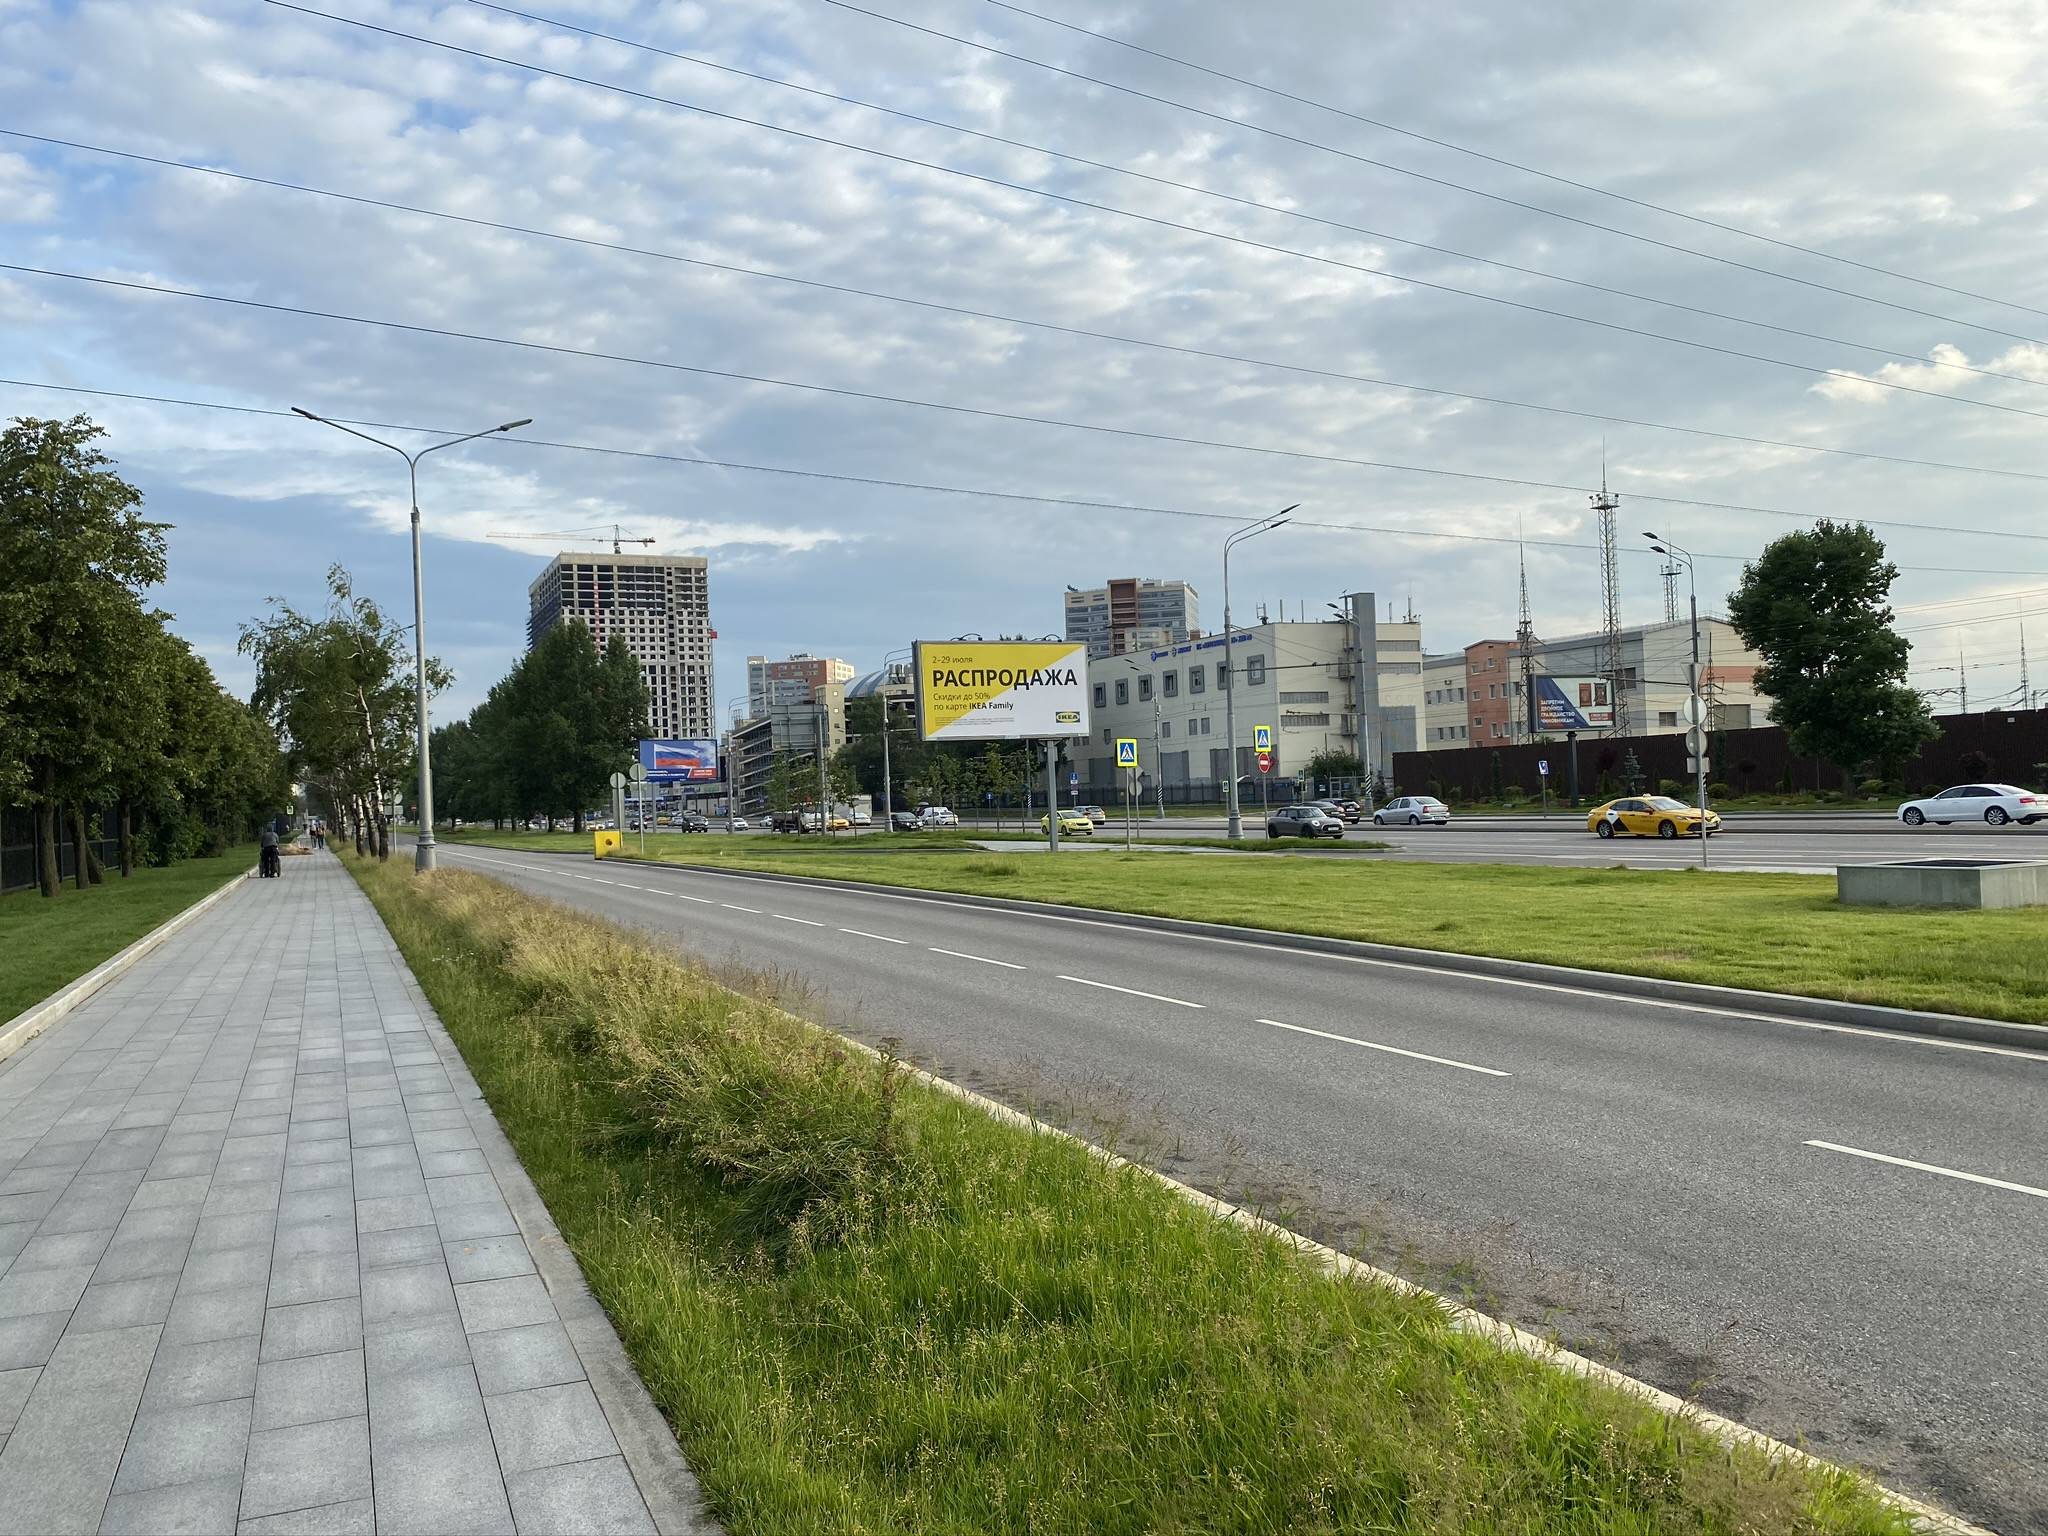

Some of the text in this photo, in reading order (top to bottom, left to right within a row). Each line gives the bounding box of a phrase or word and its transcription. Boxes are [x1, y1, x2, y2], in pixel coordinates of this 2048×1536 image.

[932, 669, 1078, 690] РАСПРОДАЖА
[933, 692, 991, 701] Скидки до 50%
[934, 701, 1014, 712] по карте IKEA Family
